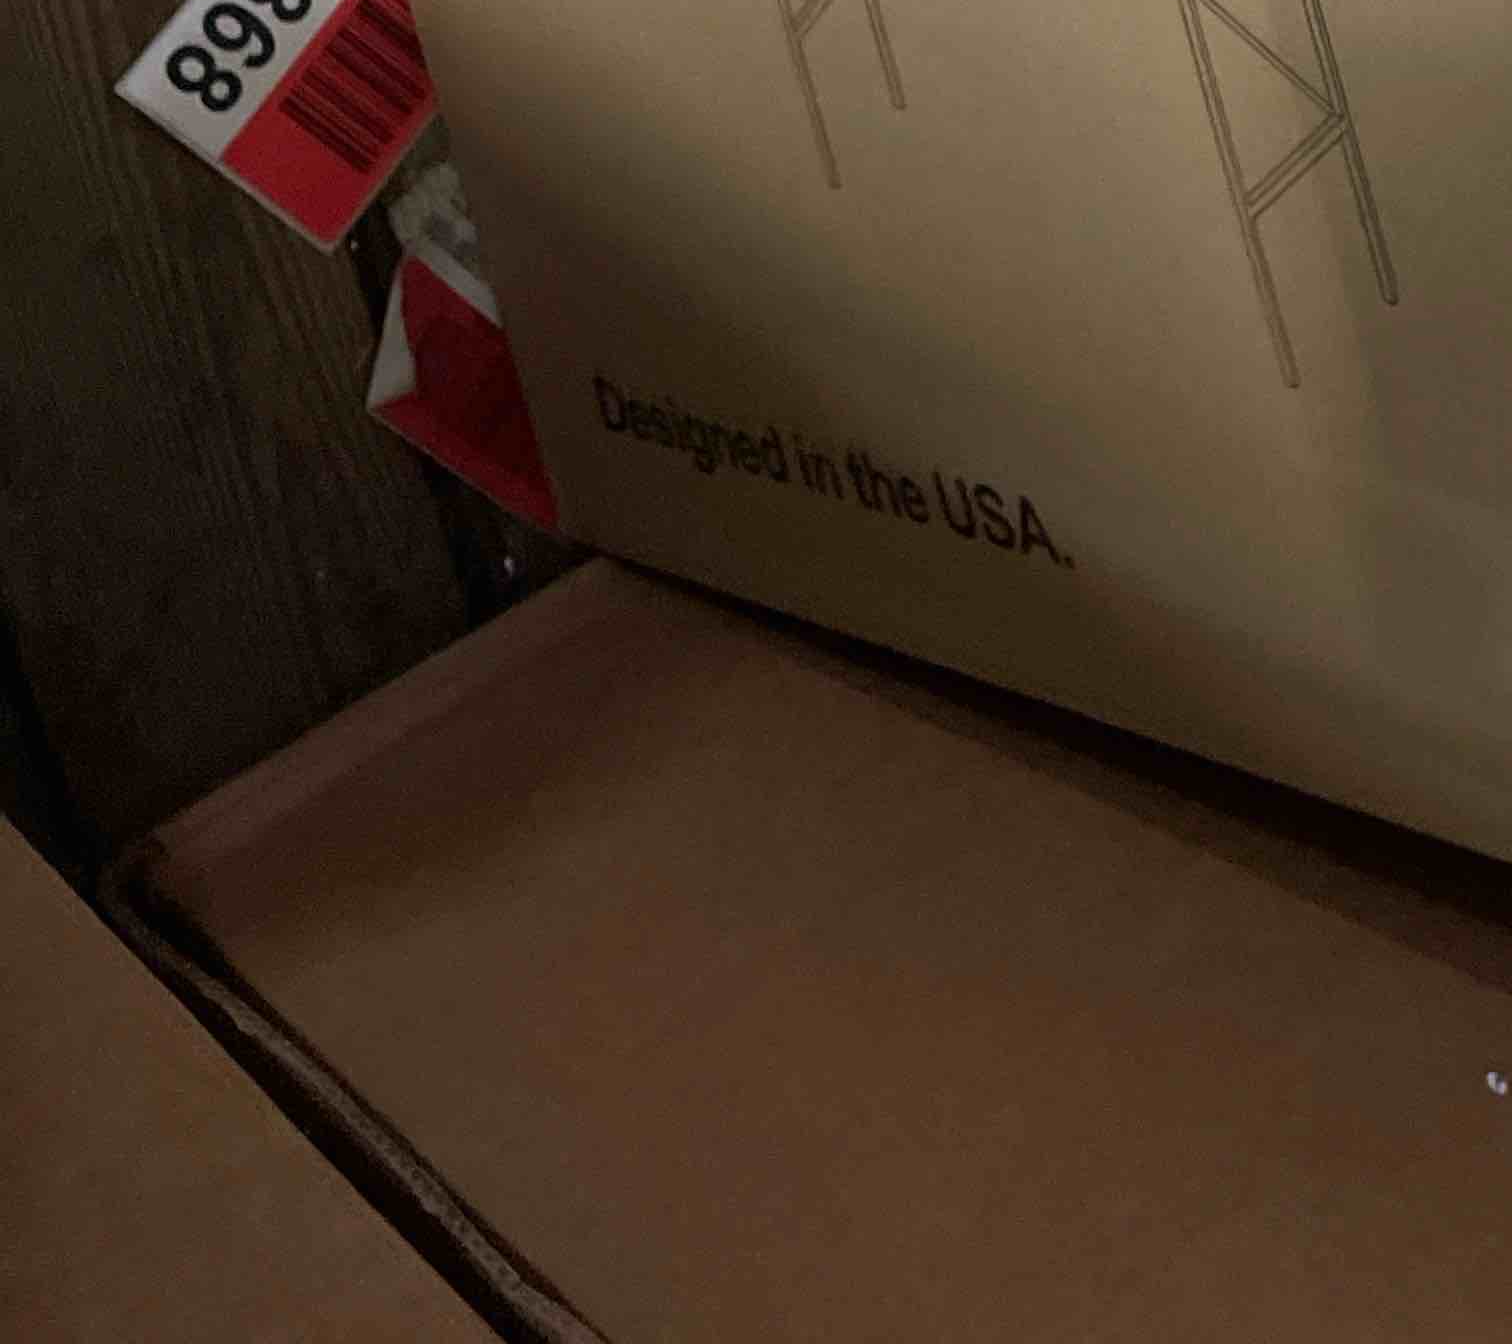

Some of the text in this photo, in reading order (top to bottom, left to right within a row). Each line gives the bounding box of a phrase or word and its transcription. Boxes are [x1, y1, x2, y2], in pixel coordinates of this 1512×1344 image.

[593, 375, 1076, 570] Designed in the USA.
